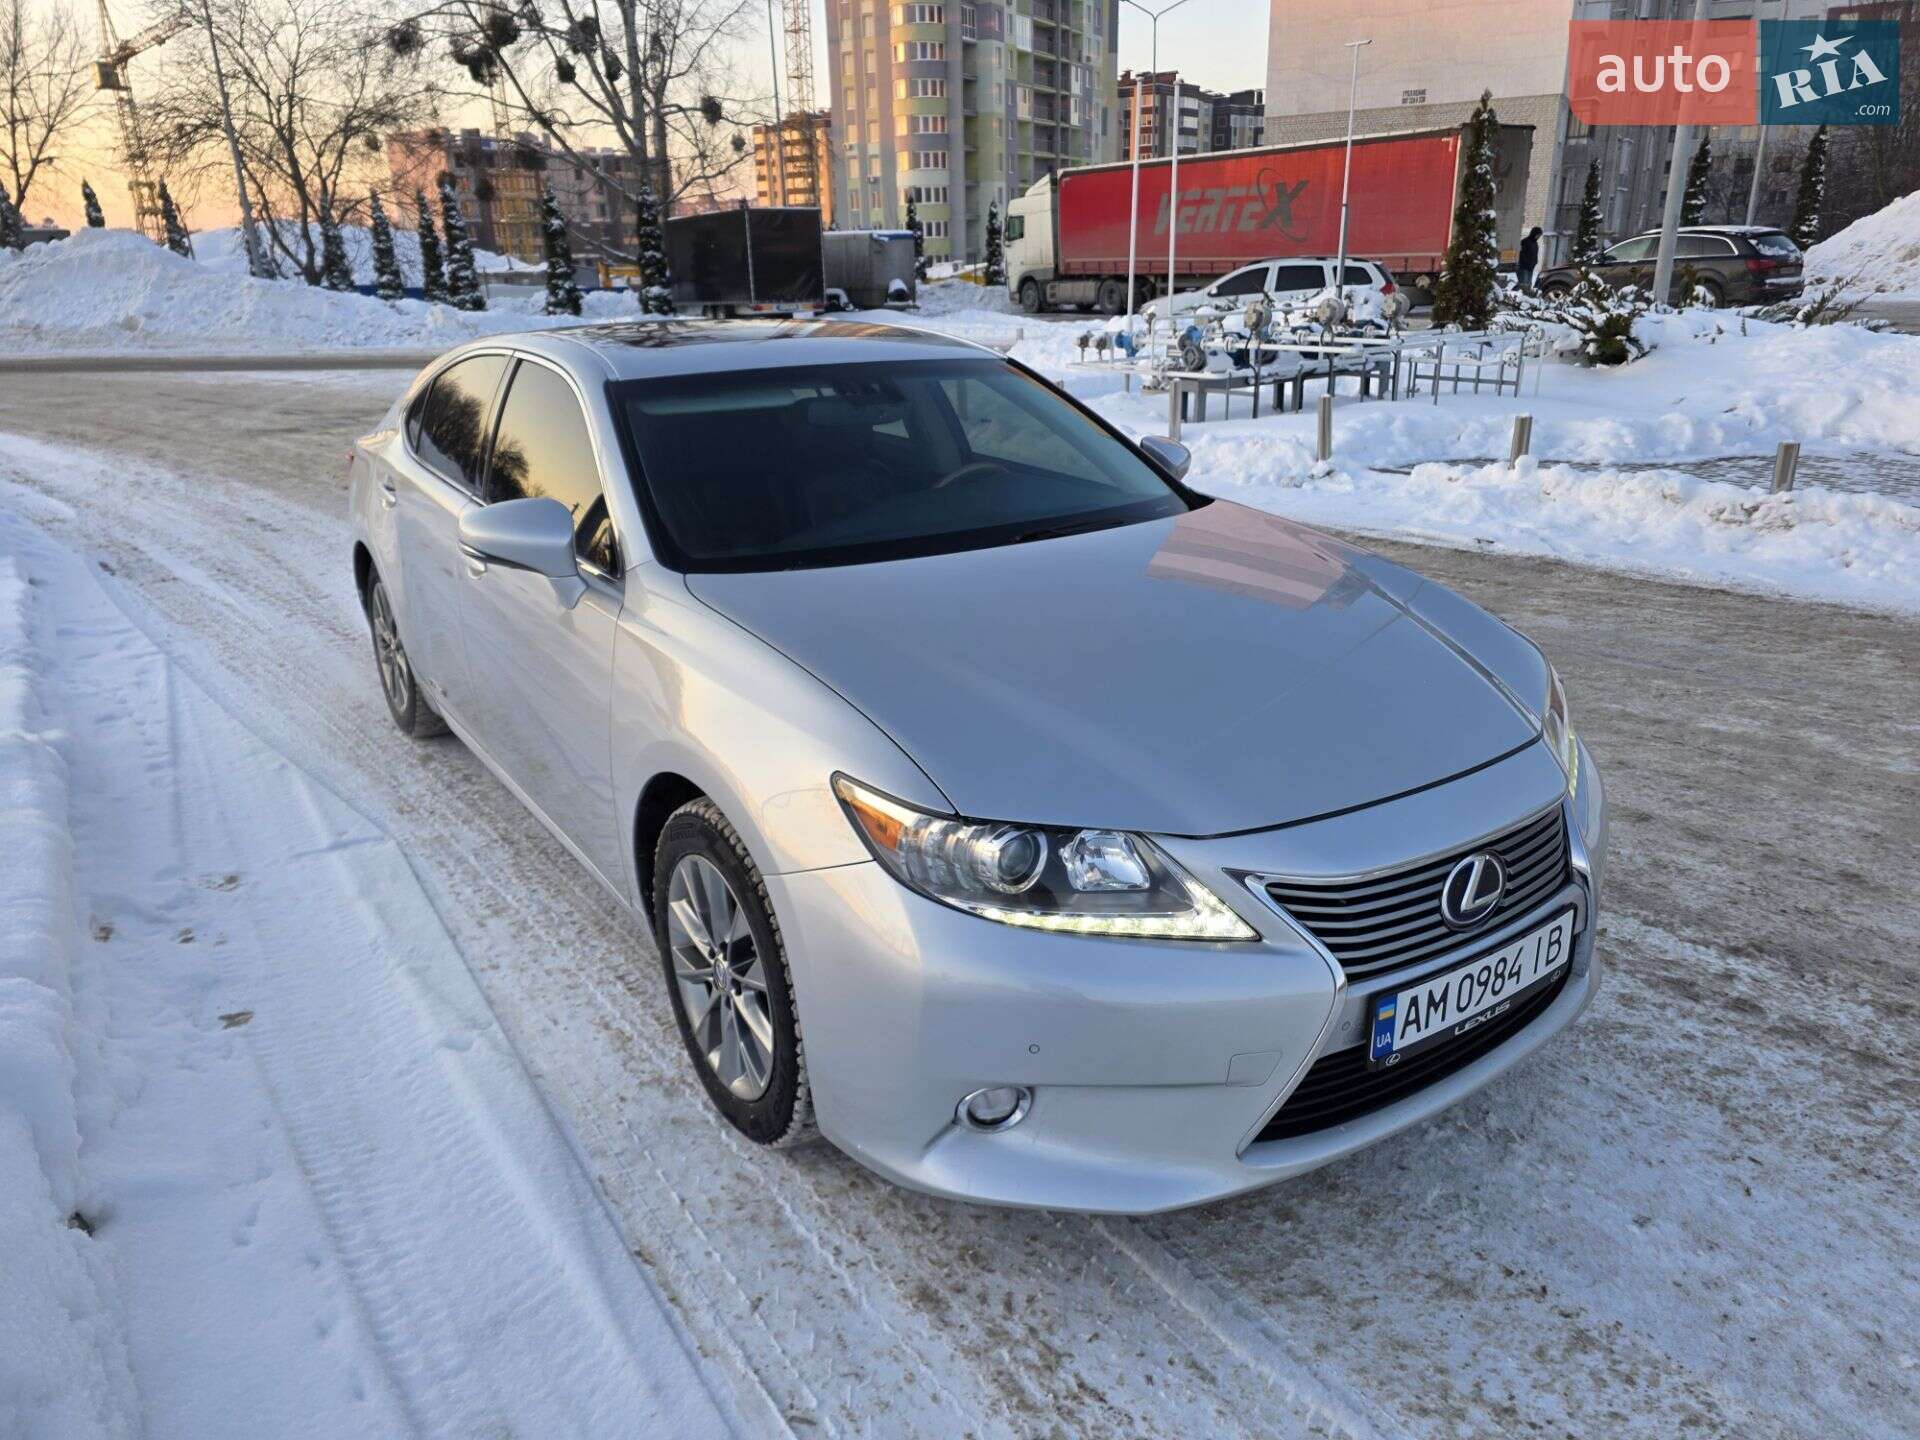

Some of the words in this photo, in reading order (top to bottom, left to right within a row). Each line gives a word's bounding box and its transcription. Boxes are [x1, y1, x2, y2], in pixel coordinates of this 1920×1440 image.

[1400, 981, 1450, 1040] AM
[1456, 945, 1523, 1014] 0984
[1533, 924, 1563, 975] IB
[1454, 1000, 1511, 1036] LEXUS
[1376, 1031, 1392, 1048] UA
